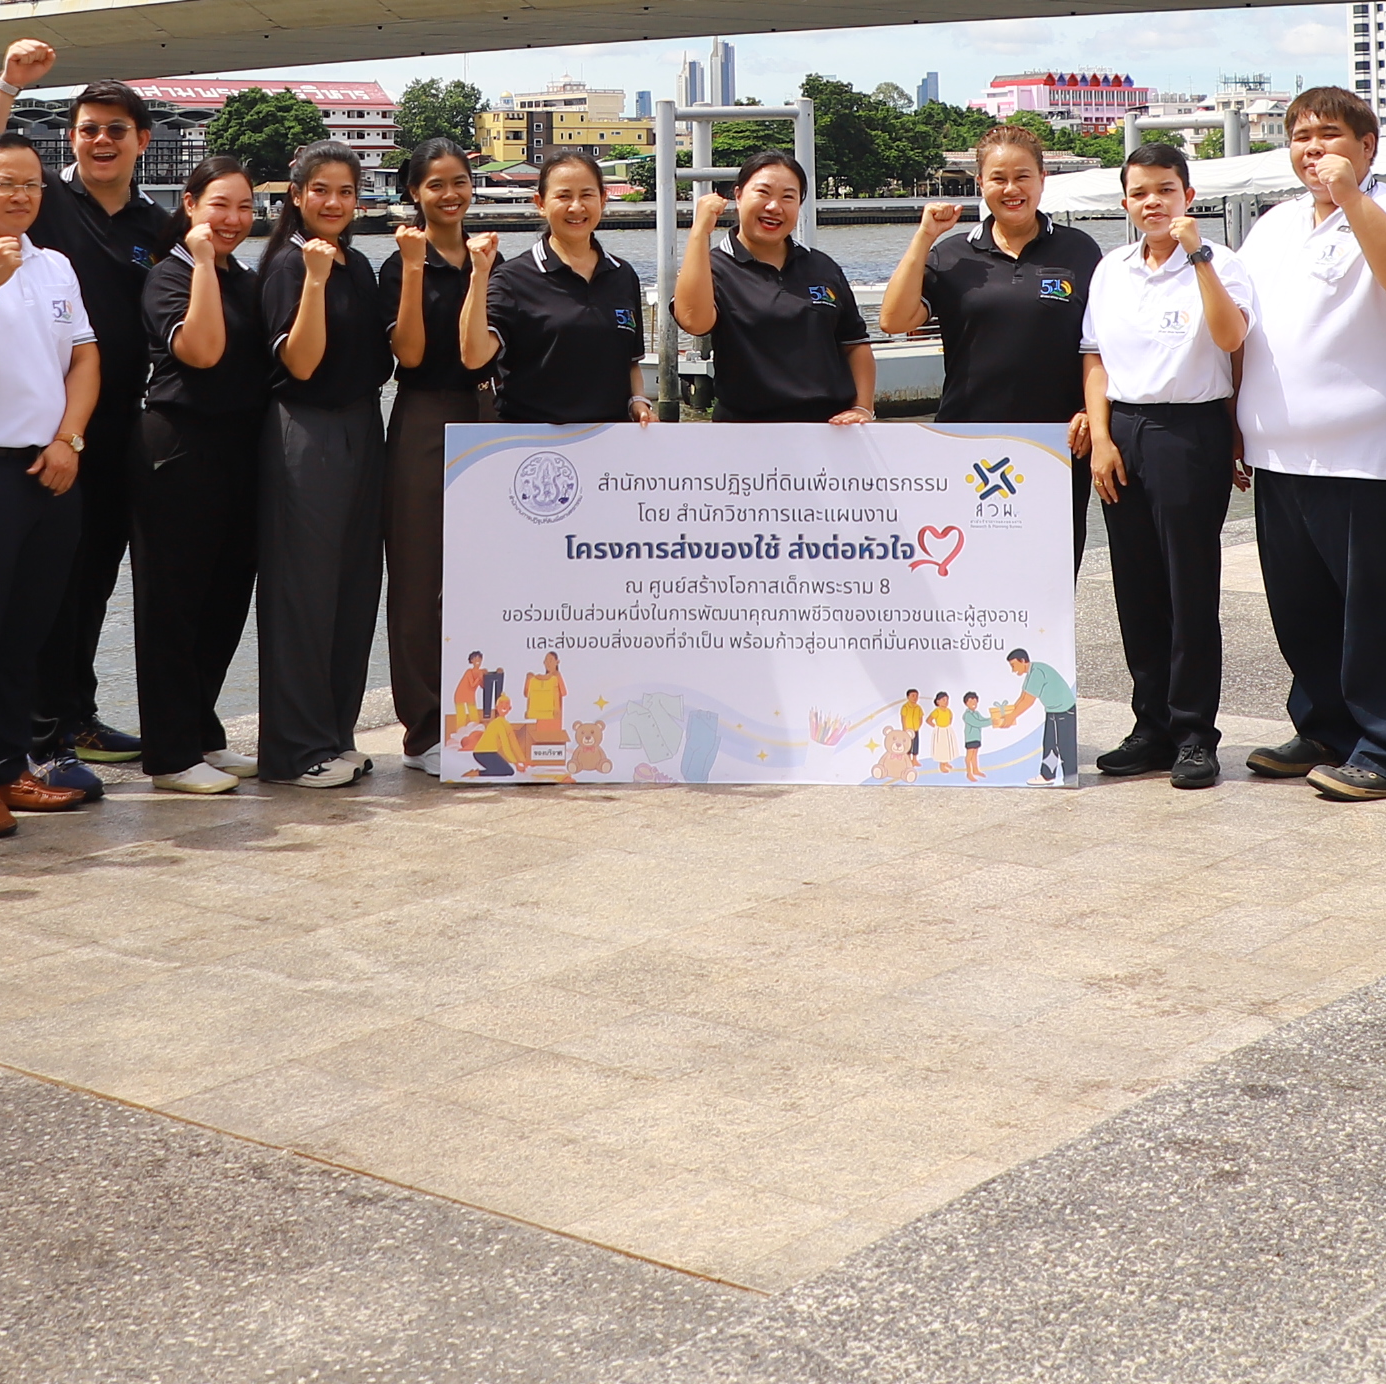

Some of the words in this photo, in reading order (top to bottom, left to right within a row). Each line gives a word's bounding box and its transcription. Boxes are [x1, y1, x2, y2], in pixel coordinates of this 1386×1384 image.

[808, 285, 828, 301] 51
[1040, 278, 1063, 295] 51
[52, 299, 67, 319] 51
[1159, 310, 1180, 330] 51
[597, 467, 948, 496] สำนักงานการปฏิรูปที่ดินเพื่อเกษตรกรรม
[638, 502, 670, 523] โดย
[676, 502, 898, 523] สำนักวิชาการและแผนงาน
[564, 532, 781, 560] โครงการส่งของใช้
[787, 533, 915, 561] ส่งต่อหัวใจ
[625, 580, 643, 594] ณ
[649, 574, 874, 599] ศูนย์สร้างโอกาสเด็กพระราม
[879, 578, 891, 594] 8
[502, 599, 1029, 628] ขอร่วมเป็นส่วนหนึ่งในการพัฒนาคุณภาพชีวิตของเยาวชนและผู้สูงอายุ
[526, 628, 724, 650] และส่งมอบสิ่งของที่จำเป็น
[729, 629, 1005, 655] พร้อมก้าวสู่อนาคตที่มั่นคงและยั่งยืน
